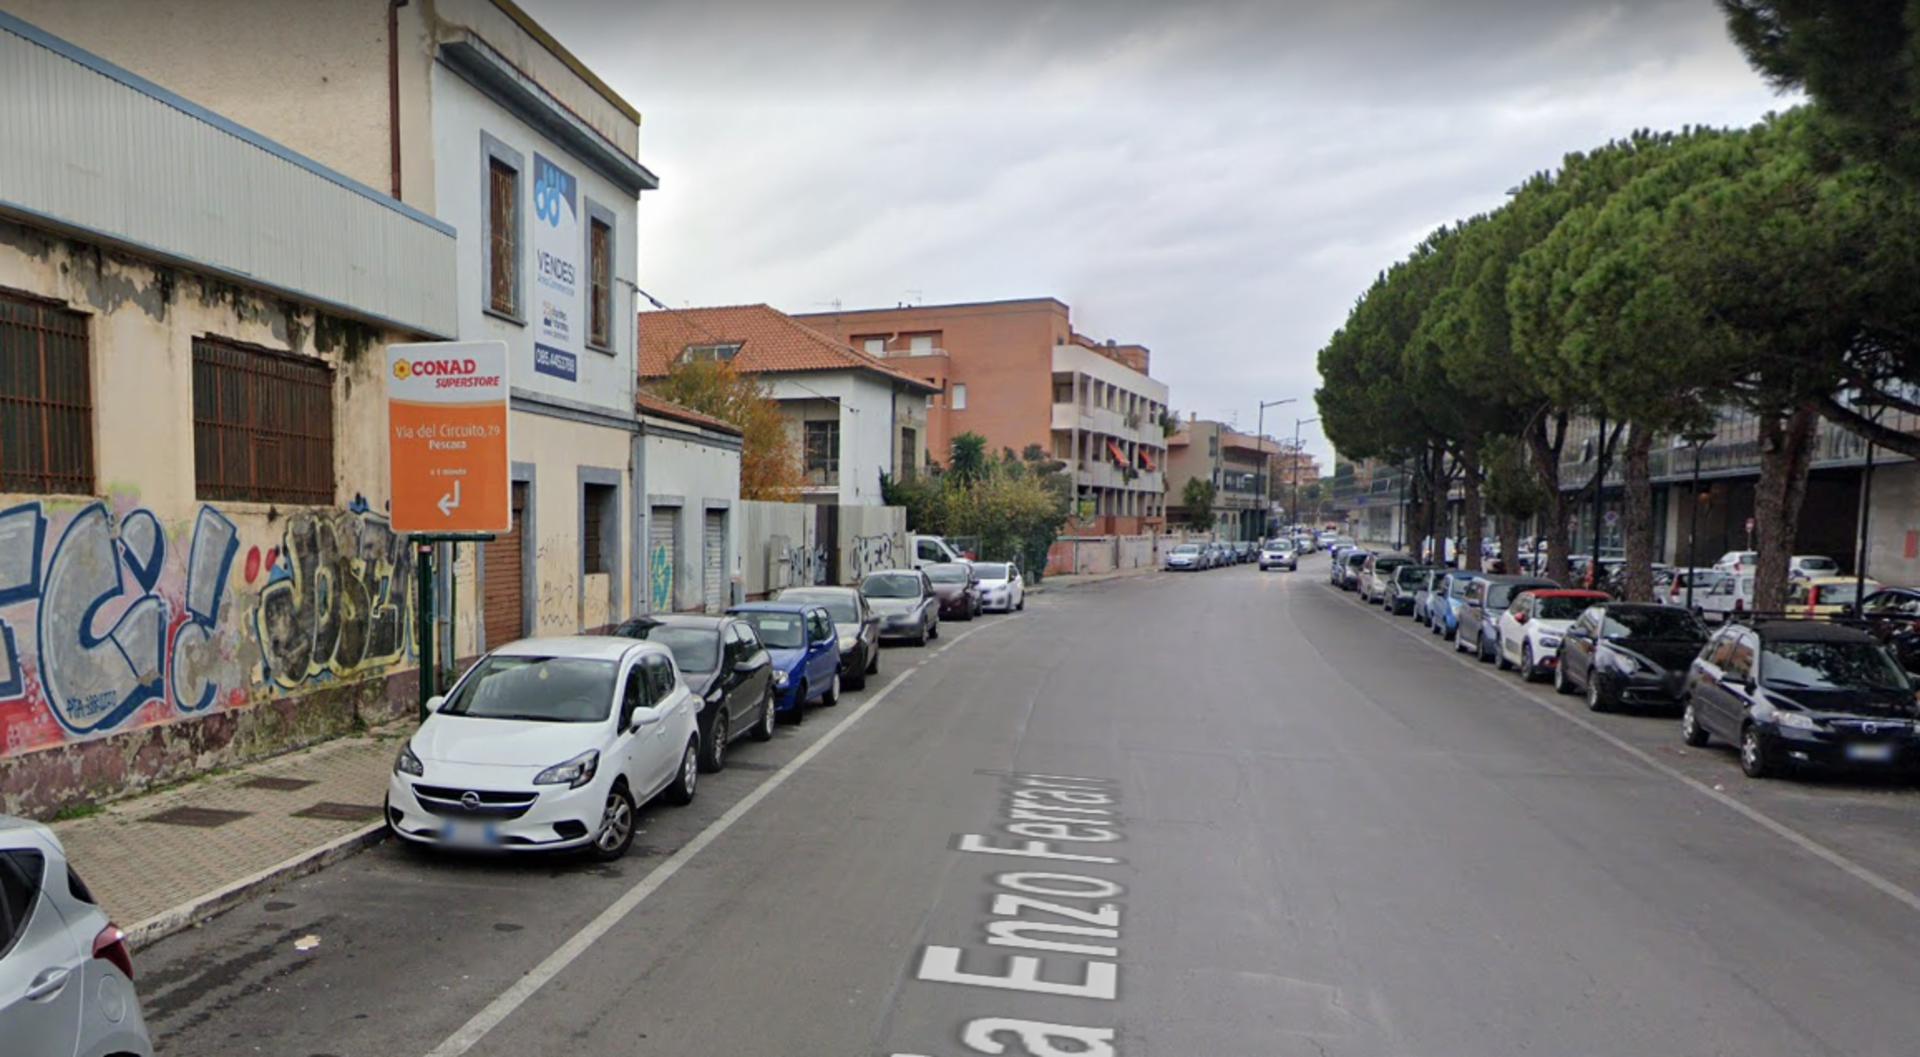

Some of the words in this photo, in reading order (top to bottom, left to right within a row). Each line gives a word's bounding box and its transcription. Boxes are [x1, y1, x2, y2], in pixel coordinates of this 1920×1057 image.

[411, 359, 476, 376] CONAD
[435, 376, 500, 389] SUPERSTORE
[396, 425, 414, 439] Via
[417, 424, 436, 438] del
[429, 439, 467, 449] Pescara
